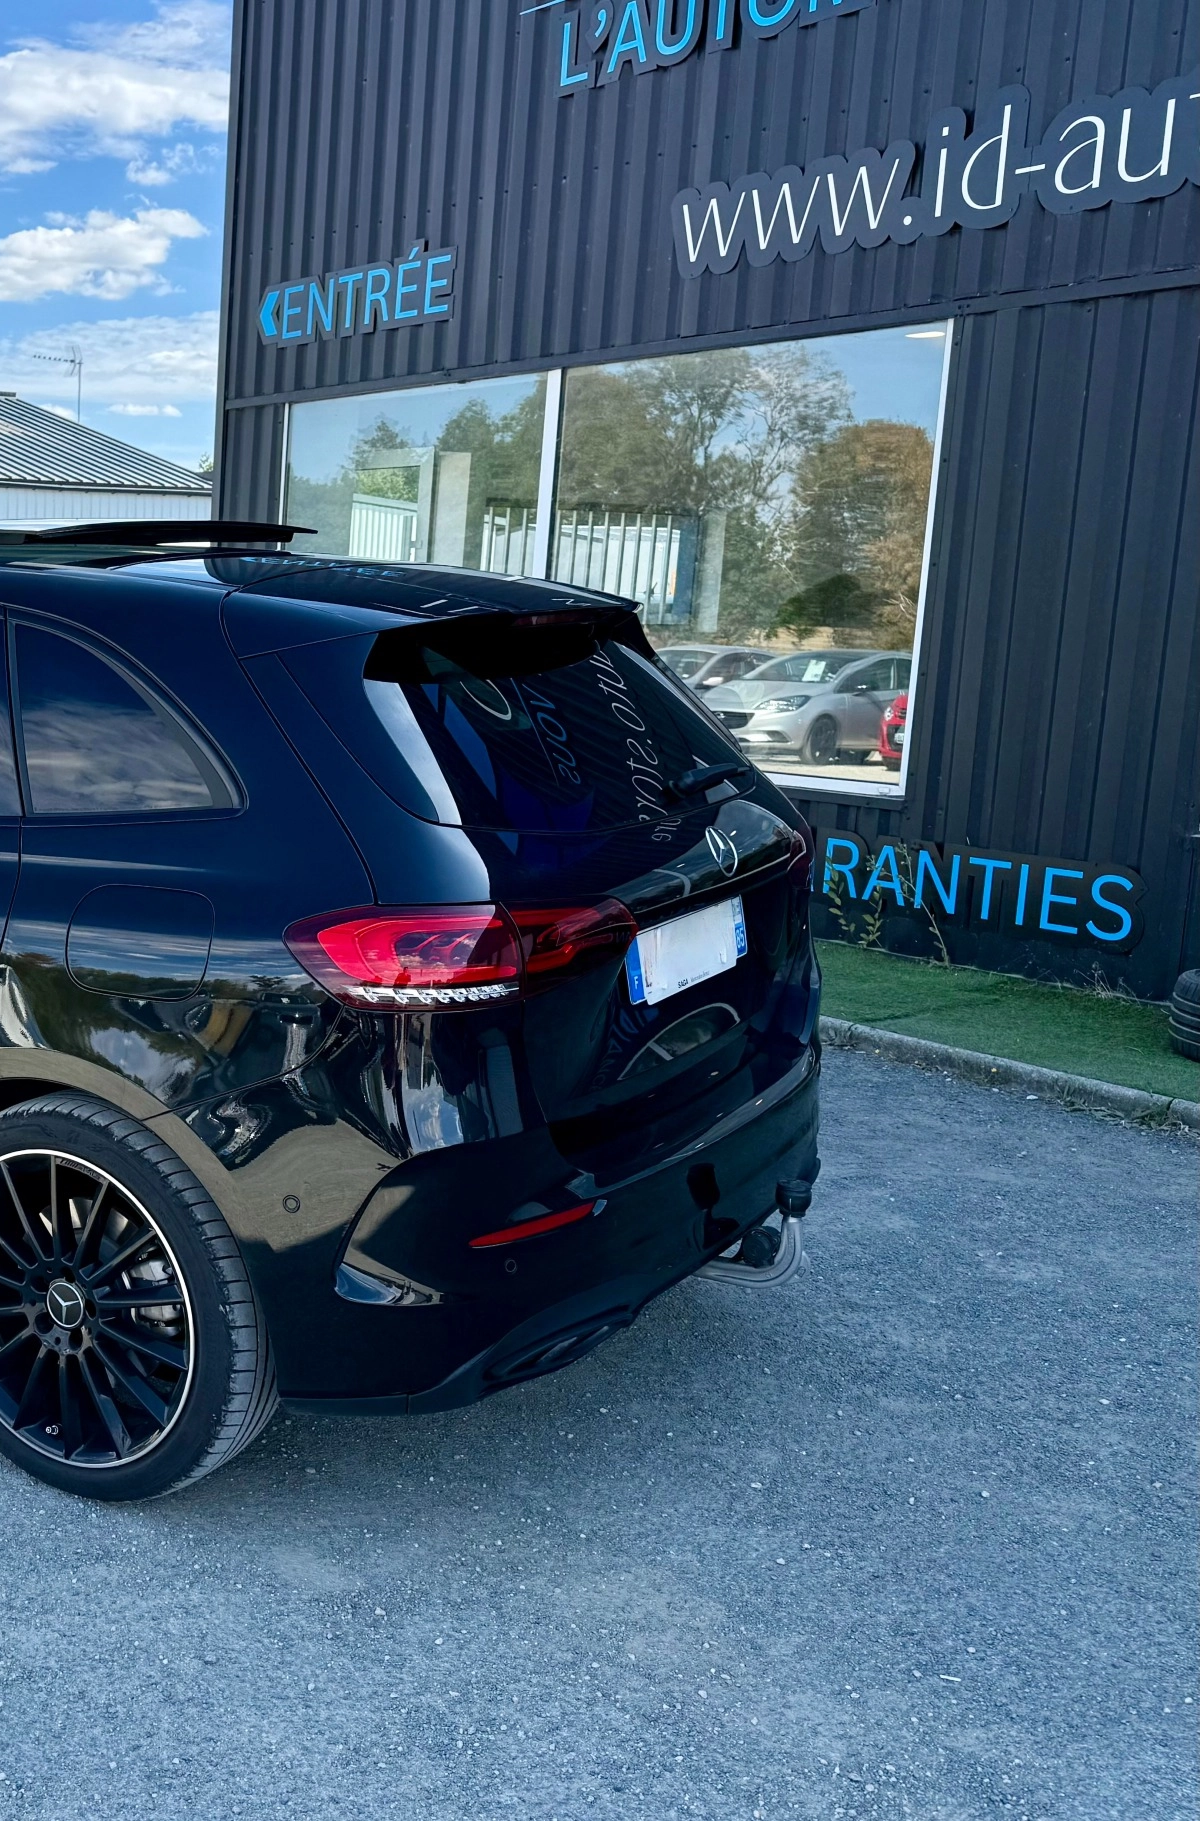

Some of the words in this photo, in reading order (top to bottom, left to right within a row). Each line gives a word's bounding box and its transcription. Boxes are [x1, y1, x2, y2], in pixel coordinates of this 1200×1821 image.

[681, 93, 1200, 262] www.id-au
[282, 246, 452, 340] ENTRÉE
[735, 927, 745, 949] 85
[809, 837, 1134, 941] RANTIES
